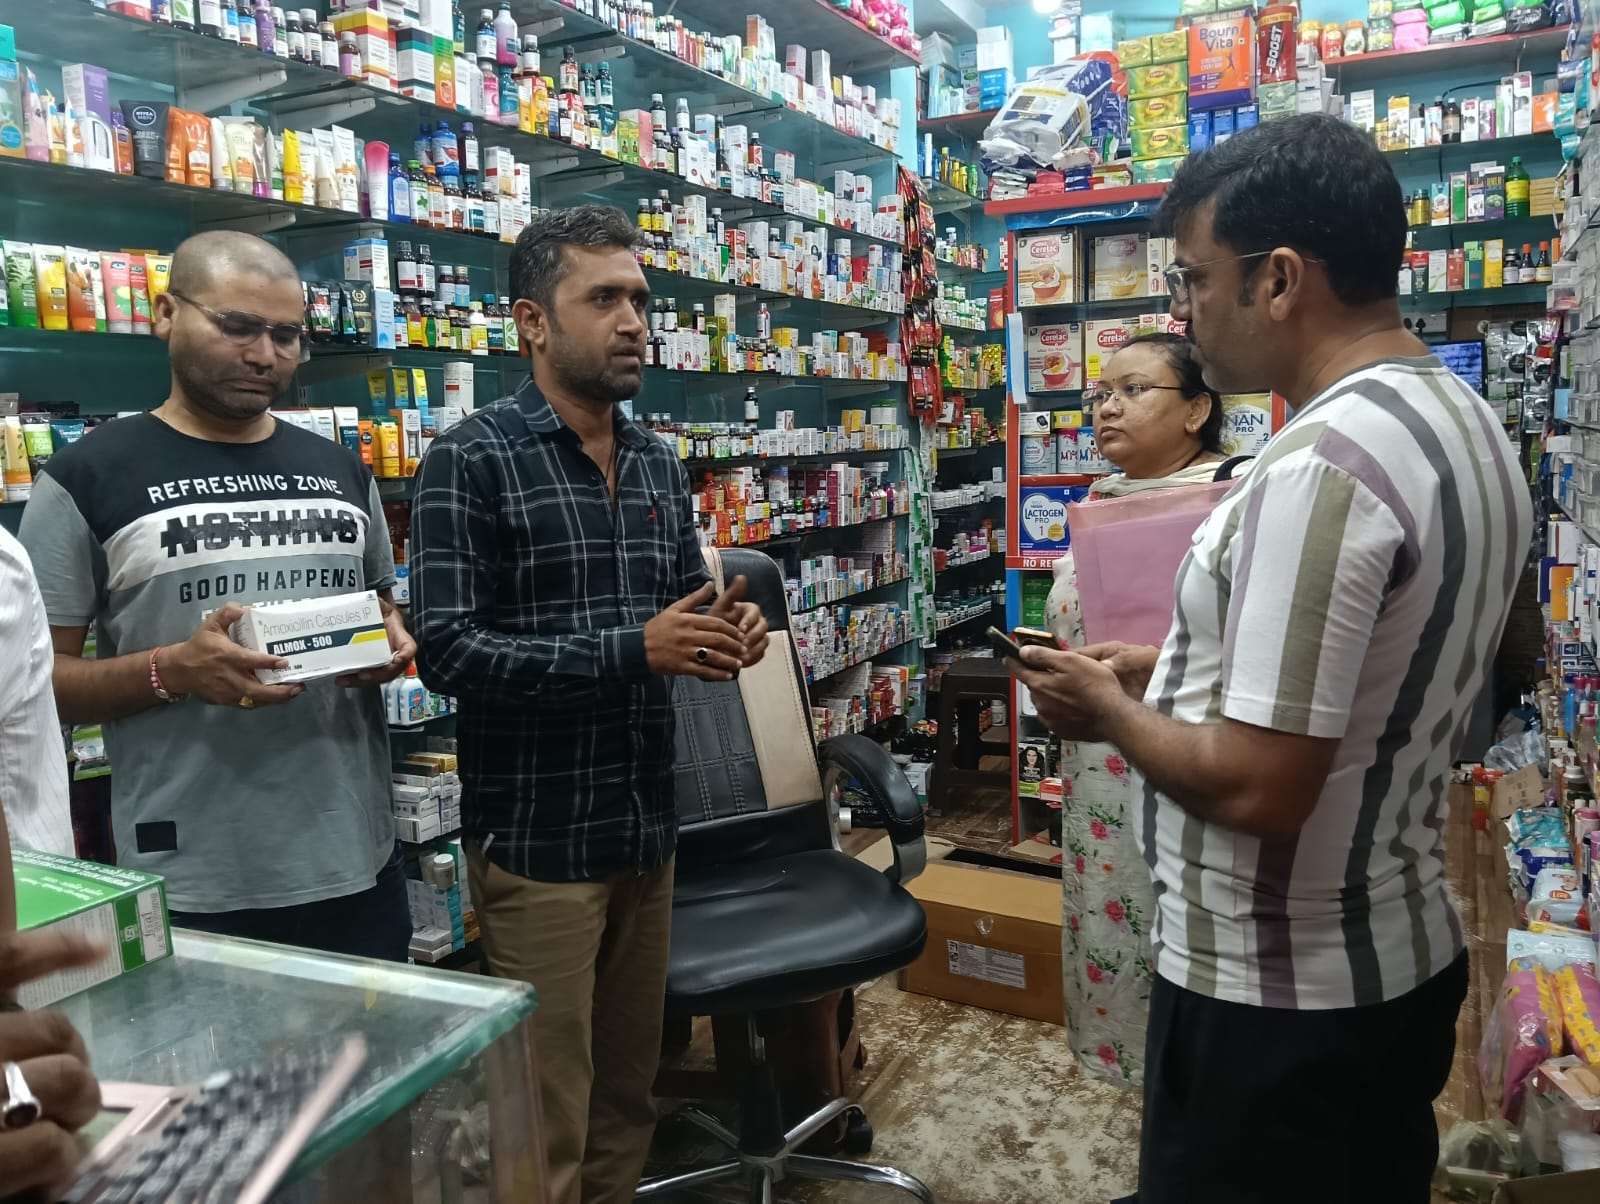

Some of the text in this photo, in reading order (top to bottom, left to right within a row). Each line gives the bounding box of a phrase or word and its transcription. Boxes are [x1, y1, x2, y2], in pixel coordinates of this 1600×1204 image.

[1200, 26, 1239, 40] Bourn
[1206, 38, 1233, 52] Vita
[1266, 25, 1283, 69] BOOST
[1031, 245, 1057, 254] Cerelac
[1041, 334, 1066, 342] Cerelac
[1099, 333, 1127, 343] Cerelac
[1263, 432, 1270, 441] 2
[148, 474, 343, 504] REFRESHING ZONE
[1025, 508, 1064, 519] LACTOGEN
[162, 508, 358, 558] NOTHING
[1039, 525, 1043, 536] 1
[1023, 559, 1053, 567] NO RE
[180, 568, 356, 604] GOOD HAPPENS
[263, 606, 371, 637] Amoxicillin Capsules IP
